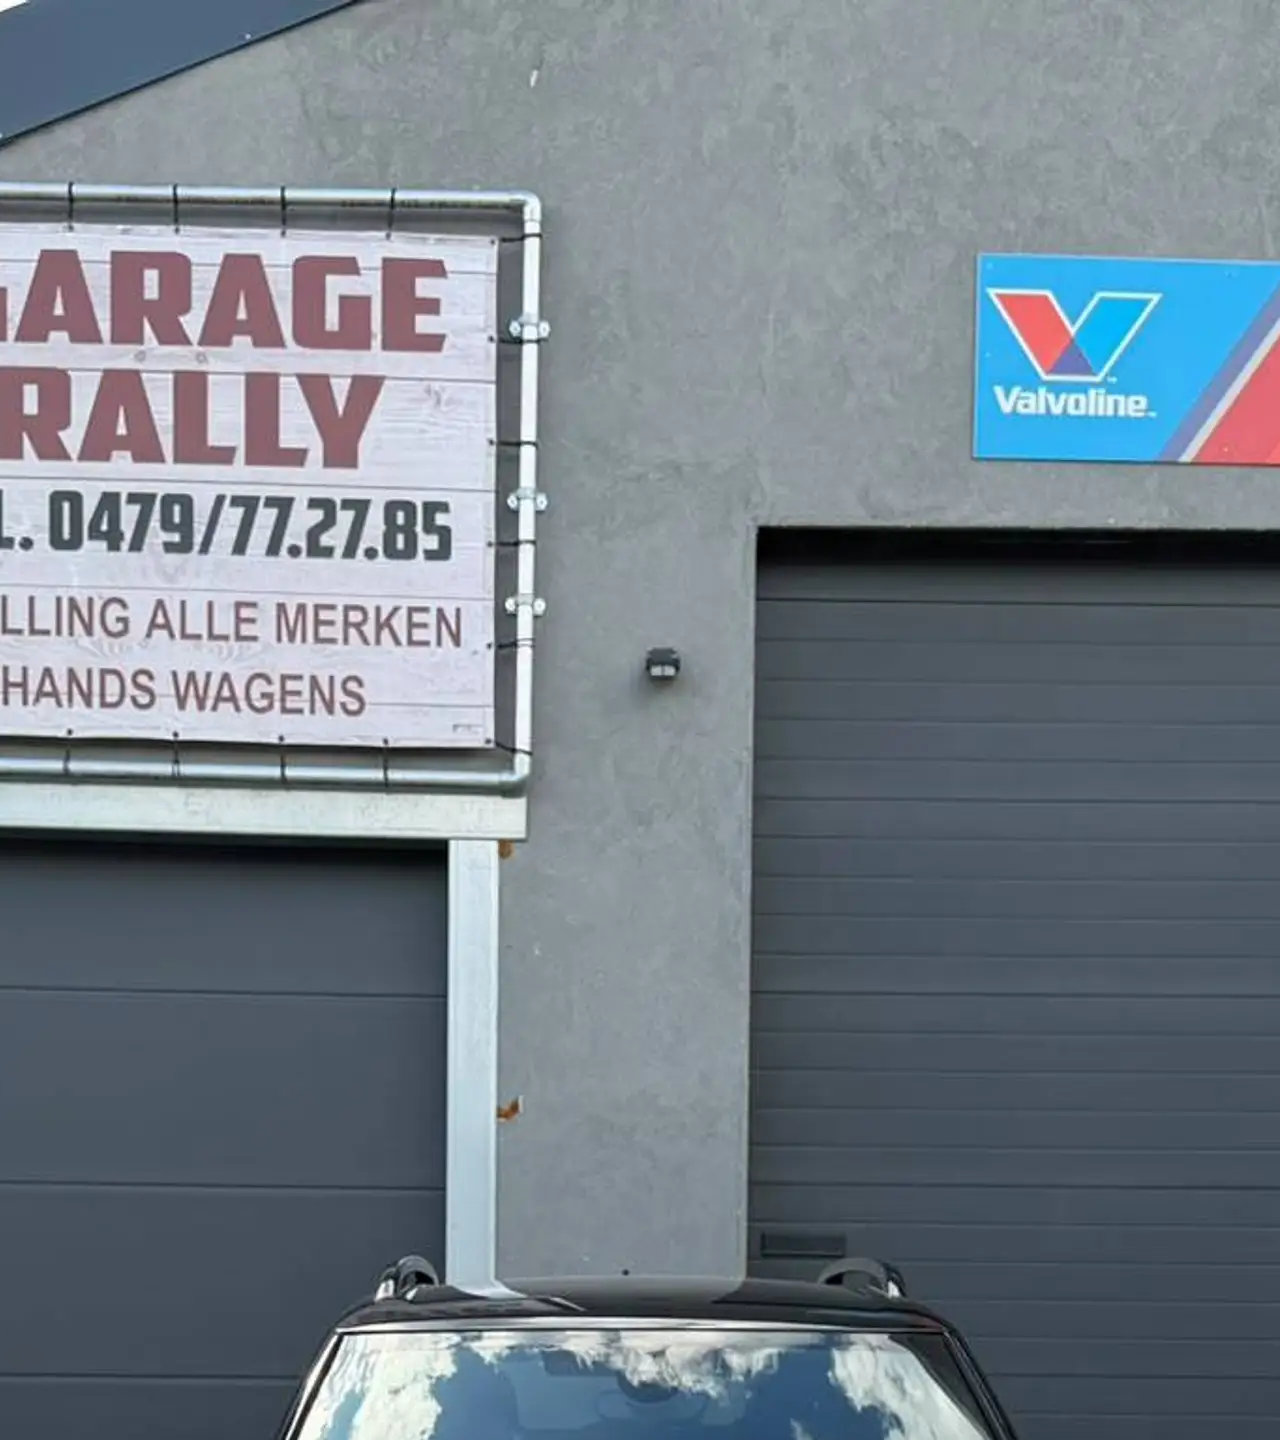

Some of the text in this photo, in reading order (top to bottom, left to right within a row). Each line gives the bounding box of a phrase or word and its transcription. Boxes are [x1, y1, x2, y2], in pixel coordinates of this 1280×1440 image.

[993, 385, 1148, 417] Valvoline
[49, 490, 452, 561] 0479/77.27.85
[146, 599, 259, 642] ALLE
[276, 602, 462, 647] MERKEN
[172, 670, 366, 717] WAGENS
